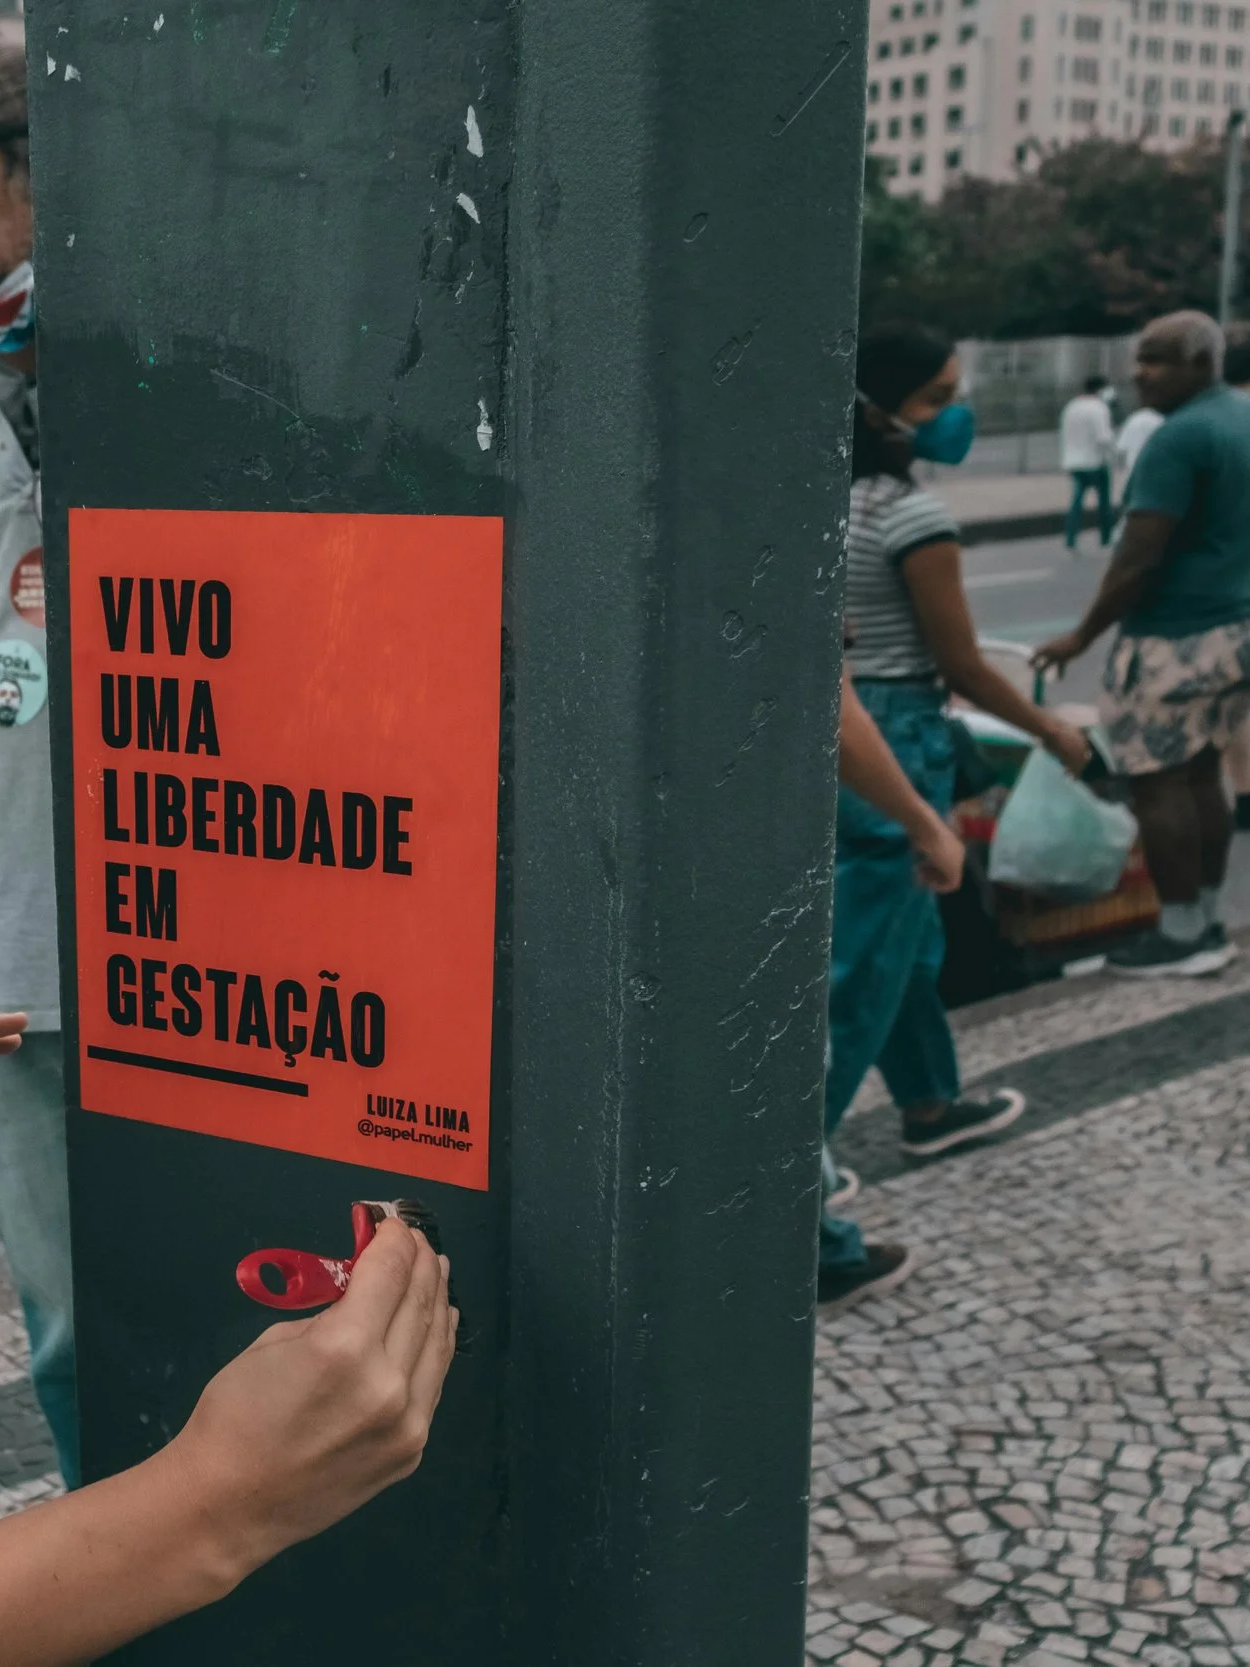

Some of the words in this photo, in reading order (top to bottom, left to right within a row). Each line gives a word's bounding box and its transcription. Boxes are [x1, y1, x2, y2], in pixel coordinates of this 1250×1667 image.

[98, 575, 232, 660] VIVO
[100, 672, 221, 757] UMA
[102, 767, 413, 877] LIBERDADE
[104, 861, 178, 942] EM
[106, 953, 386, 1069] GESTAÇÃO
[366, 1093, 418, 1124] LUIZA
[425, 1104, 470, 1134] LIMA
